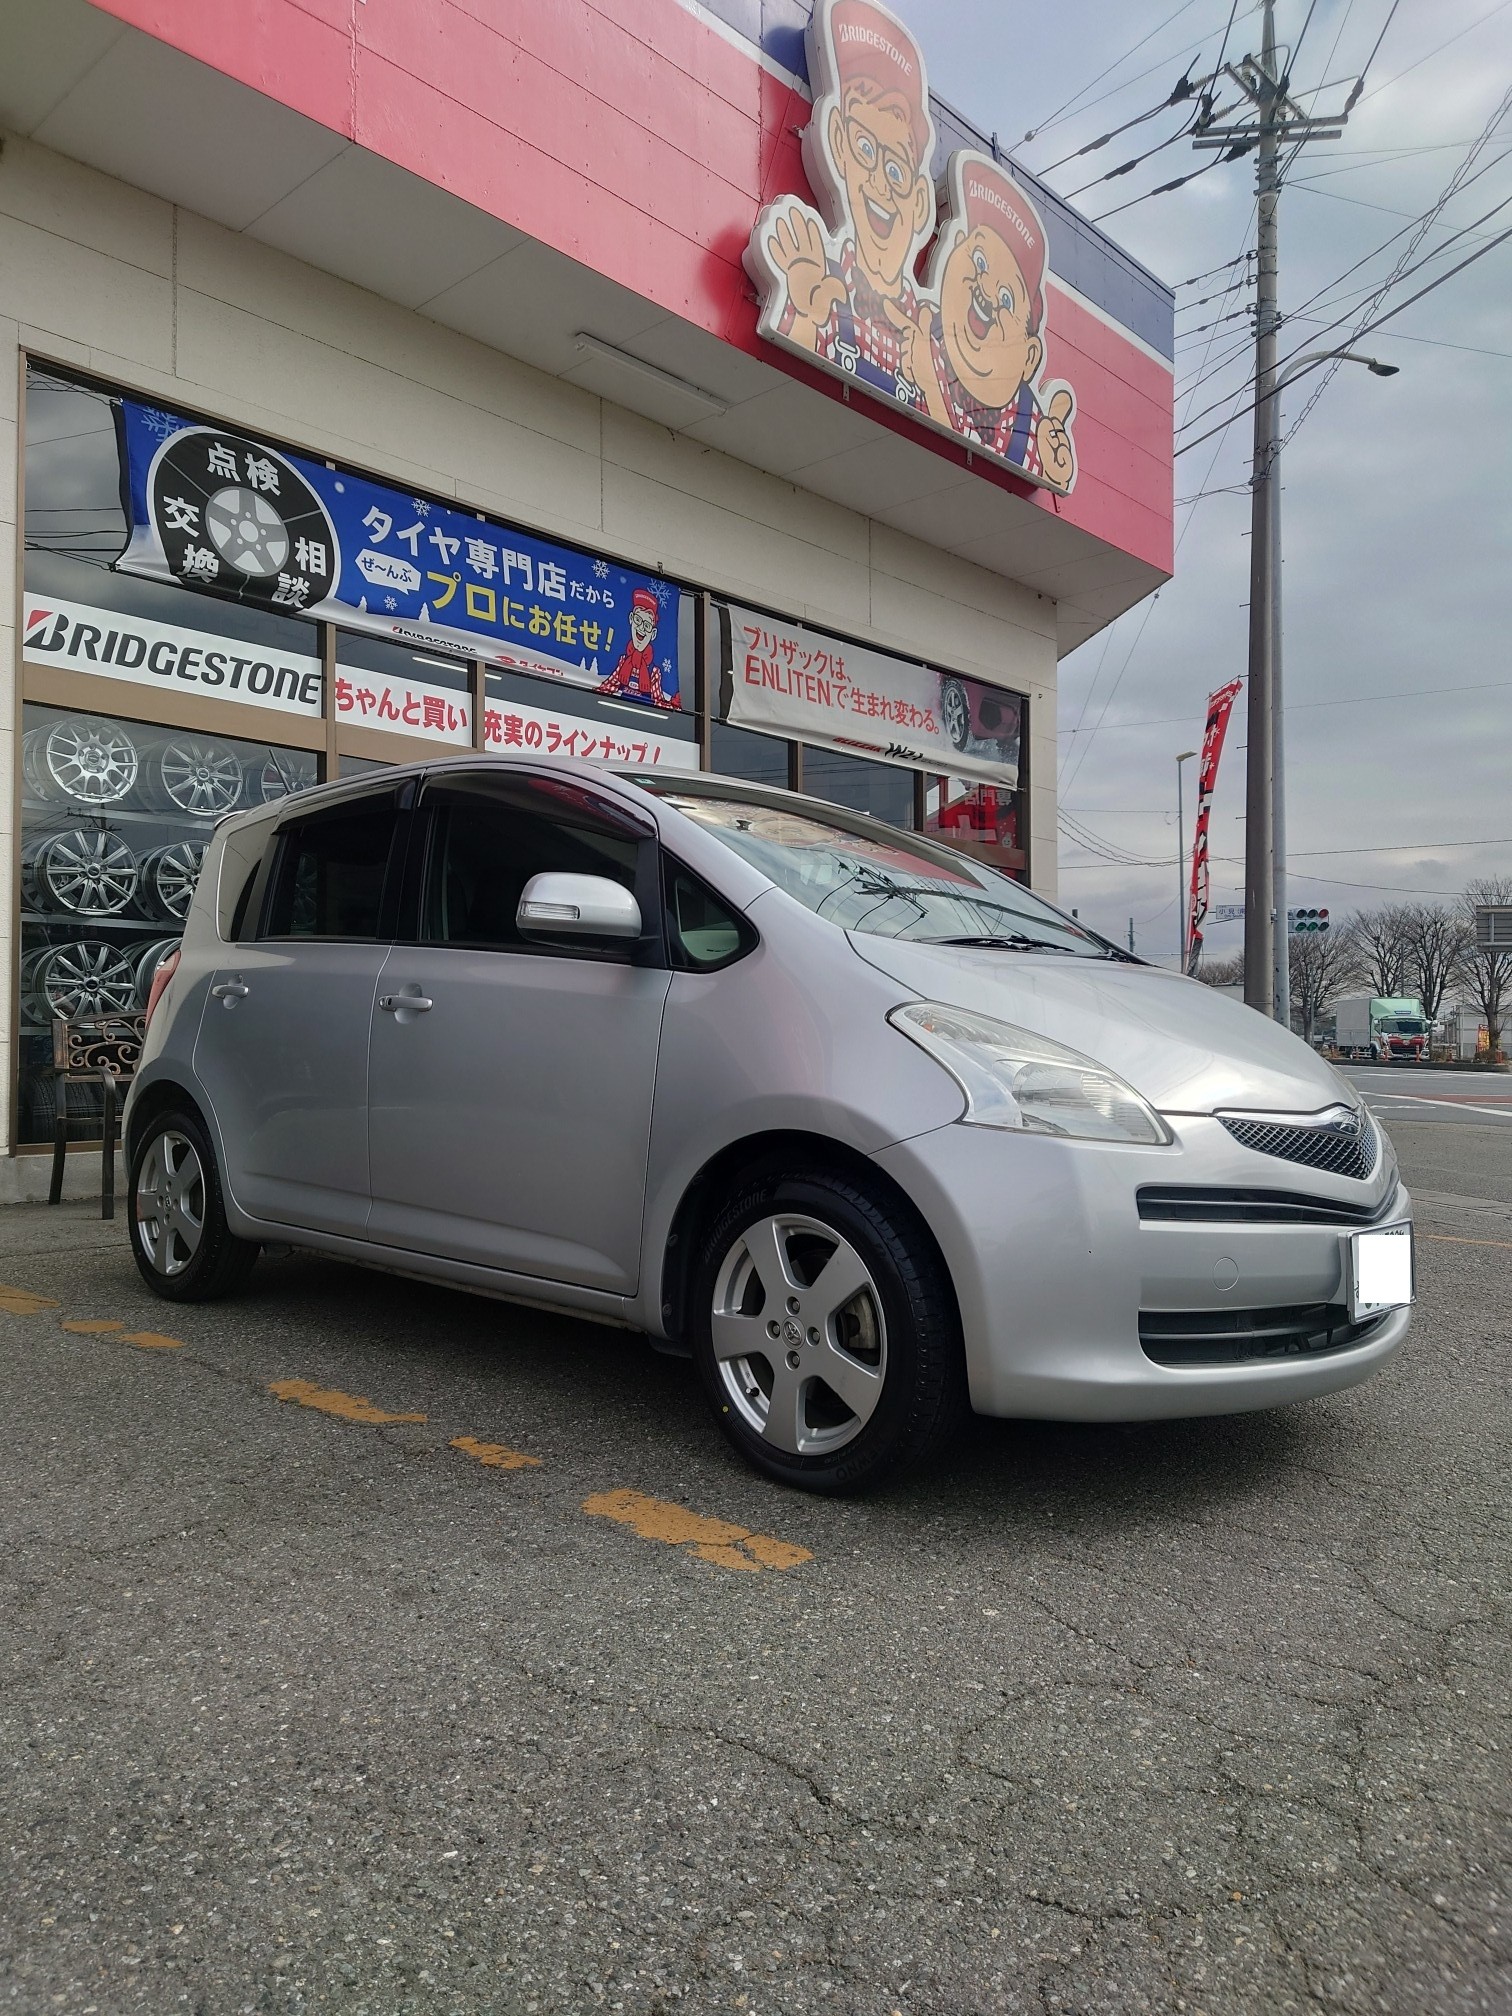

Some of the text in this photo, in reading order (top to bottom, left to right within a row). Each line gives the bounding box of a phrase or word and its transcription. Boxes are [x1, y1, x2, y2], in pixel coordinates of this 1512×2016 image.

[838, 23, 914, 77] BRIDGESTONE
[969, 179, 1036, 250] BRIDGESTONE
[206, 441, 281, 496] 点検
[162, 495, 220, 584] 交換
[271, 536, 327, 609] 相談
[361, 505, 616, 609] タイヤ専門店だから
[426, 570, 616, 653] プロにお任せ！
[23, 608, 322, 706] BRIDGESTONE
[743, 625, 853, 684] ブリザックは、
[334, 677, 469, 732] ちゃんと買い
[485, 708, 662, 765] 充実のラインナップ！
